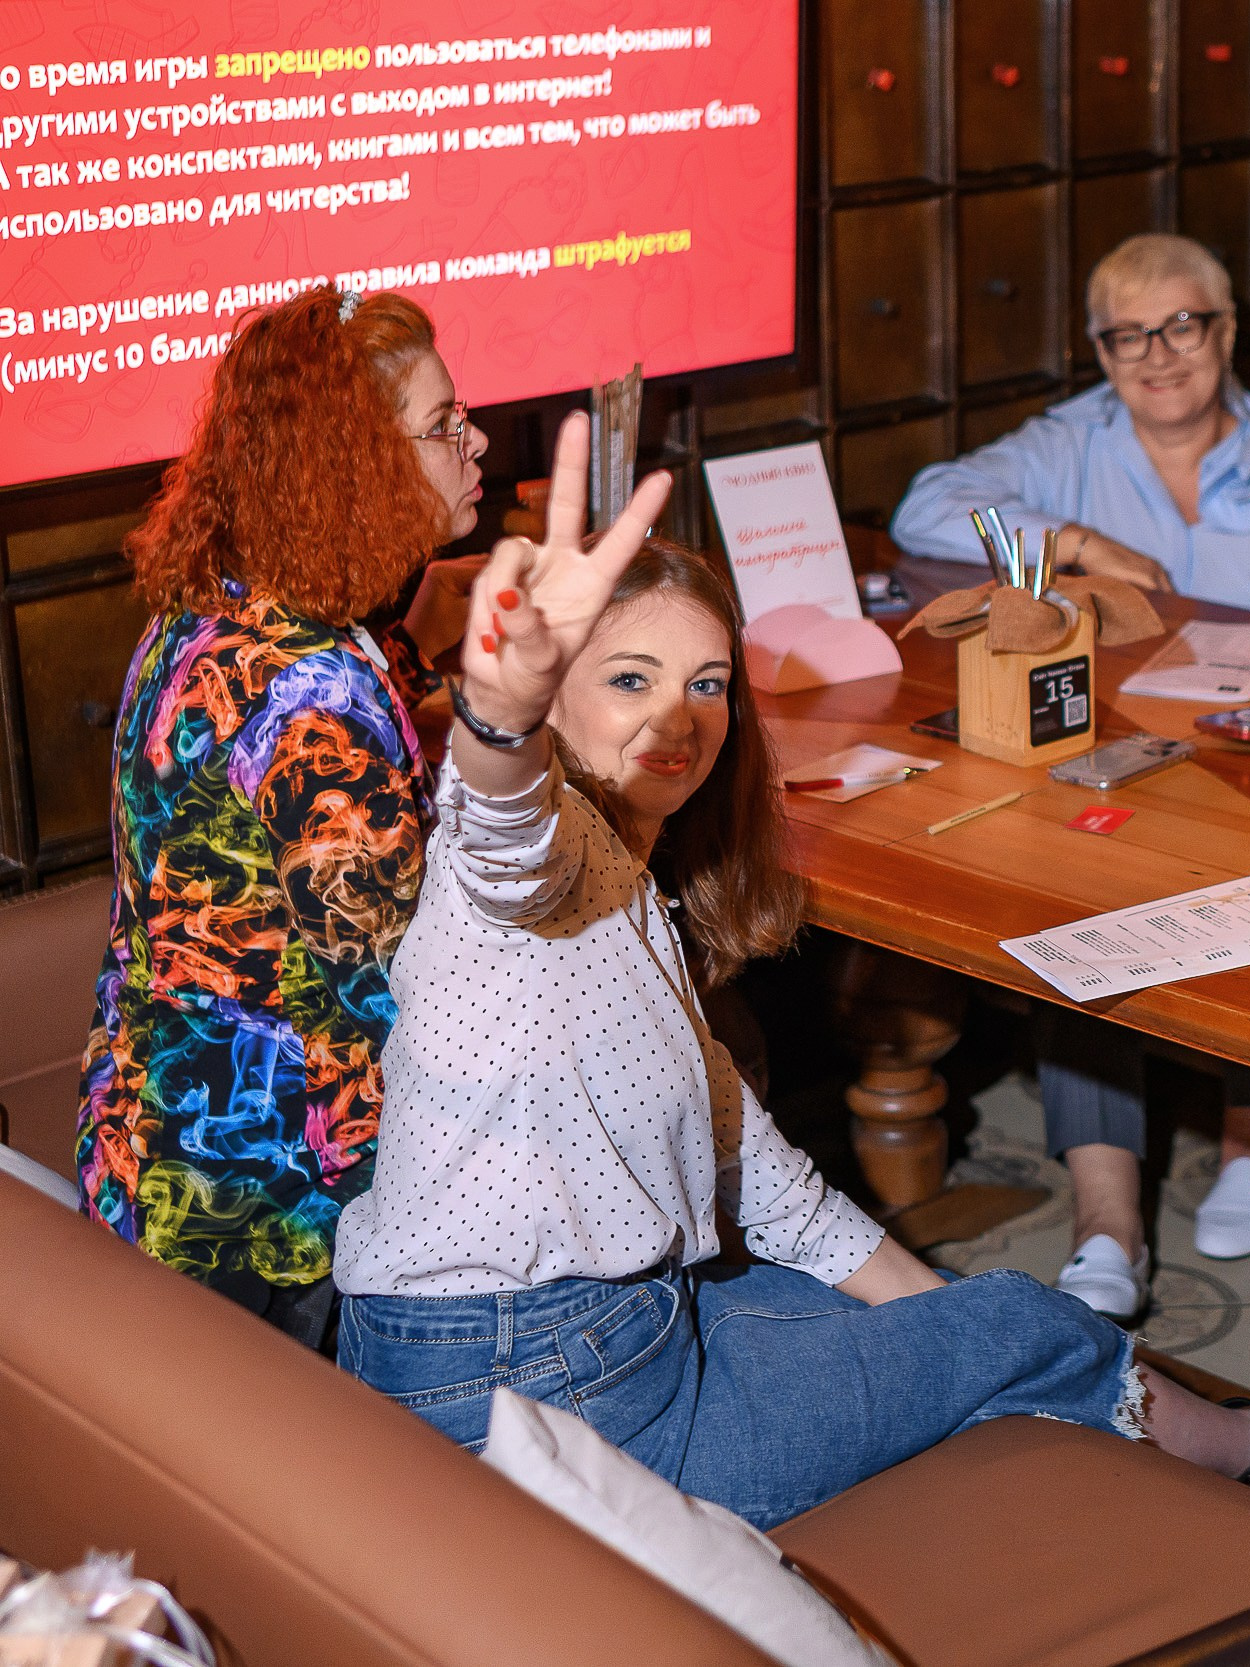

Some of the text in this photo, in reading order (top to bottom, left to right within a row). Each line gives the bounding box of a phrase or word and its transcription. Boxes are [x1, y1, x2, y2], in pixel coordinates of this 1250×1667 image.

[29, 60, 127, 96] время
[135, 53, 208, 89] игры
[214, 45, 370, 80] запрещено
[375, 36, 546, 68] пользоваться
[550, 25, 691, 59] телефонами
[696, 27, 711, 46] и
[124, 94, 325, 139] устройствами
[331, 93, 346, 116] с
[352, 82, 469, 117] выходом
[474, 83, 490, 105] в
[494, 69, 612, 106] интернет!
[16, 163, 70, 189] так
[78, 157, 119, 182] же
[127, 142, 322, 179] конспектами,
[328, 130, 438, 163] книгами
[443, 130, 458, 151] и
[464, 125, 524, 149] всем
[529, 119, 581, 146] тем,
[584, 115, 625, 138] что
[629, 107, 703, 134] может
[705, 99, 760, 128] быть
[209, 190, 261, 227] для
[266, 172, 410, 215] читерства!
[0, 308, 34, 337] За
[43, 290, 209, 337] нарушение
[334, 257, 440, 294] правила
[446, 246, 550, 282] команда
[554, 229, 691, 270] штрафуется
[2, 347, 108, 393] (минус
[115, 342, 144, 370] 10
[1045, 675, 1074, 704] 15
